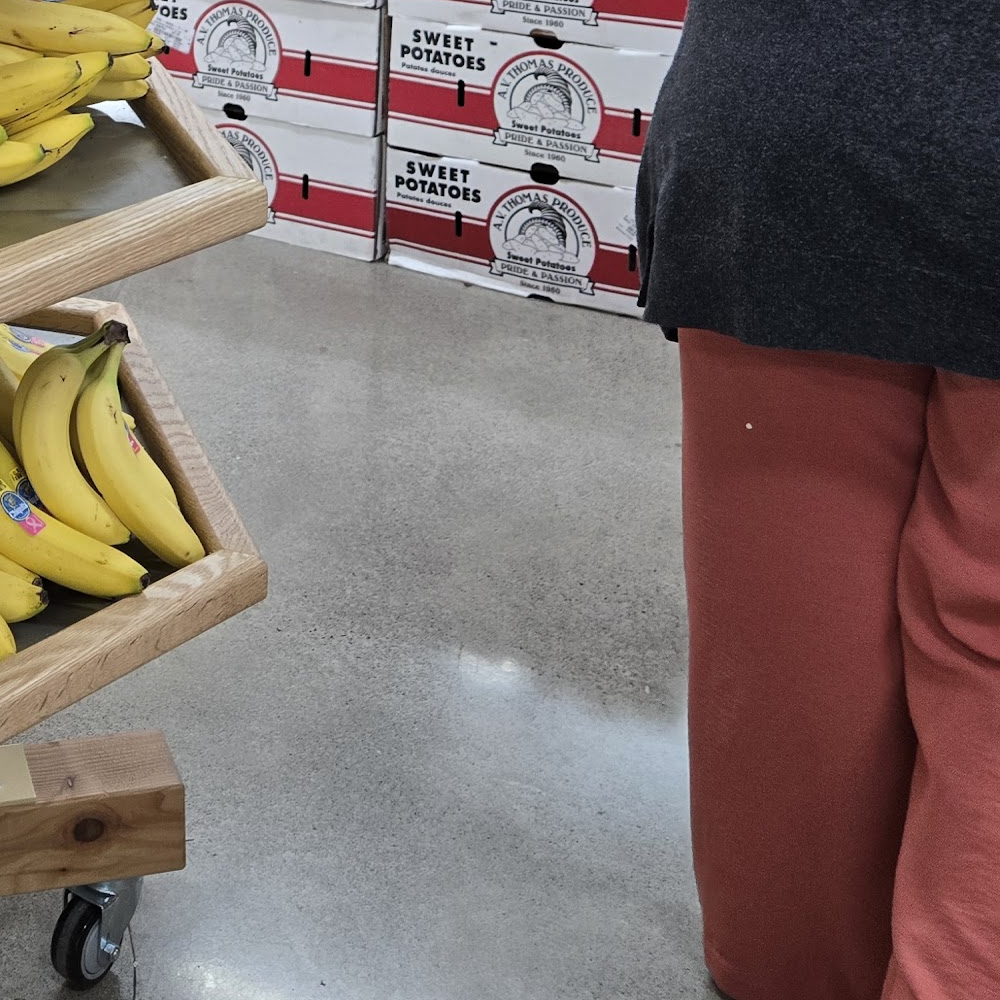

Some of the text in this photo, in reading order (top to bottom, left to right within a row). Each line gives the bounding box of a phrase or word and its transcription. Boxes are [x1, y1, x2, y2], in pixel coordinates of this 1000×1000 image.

[502, 0, 531, 11] PRIDE
[543, 5, 586, 18] PASSION
[206, 6, 243, 27] THOMAS
[246, 10, 276, 56] PRODUCE
[545, 18, 564, 28] 1960
[412, 29, 474, 52] SWEET
[400, 44, 486, 71] POTATOES
[207, 64, 263, 80] Sweet Potatoes
[202, 75, 226, 86] PRIDE
[235, 81, 268, 93] PASSION
[506, 58, 554, 81] THOMAS
[556, 62, 597, 114] PRODUCE
[511, 119, 581, 139] Sweet Potatoes
[504, 131, 534, 145] PRIDE
[546, 139, 588, 153] PASSION
[242, 134, 273, 180] PRODUCE
[406, 161, 469, 184] SWEET
[395, 175, 481, 203] POTATOES
[501, 192, 549, 215] THOMAS
[552, 197, 592, 248] PRODUCE
[507, 251, 576, 272] Sweet Potatoes
[501, 263, 529, 277] PRIDE
[541, 271, 583, 286] PASSION
